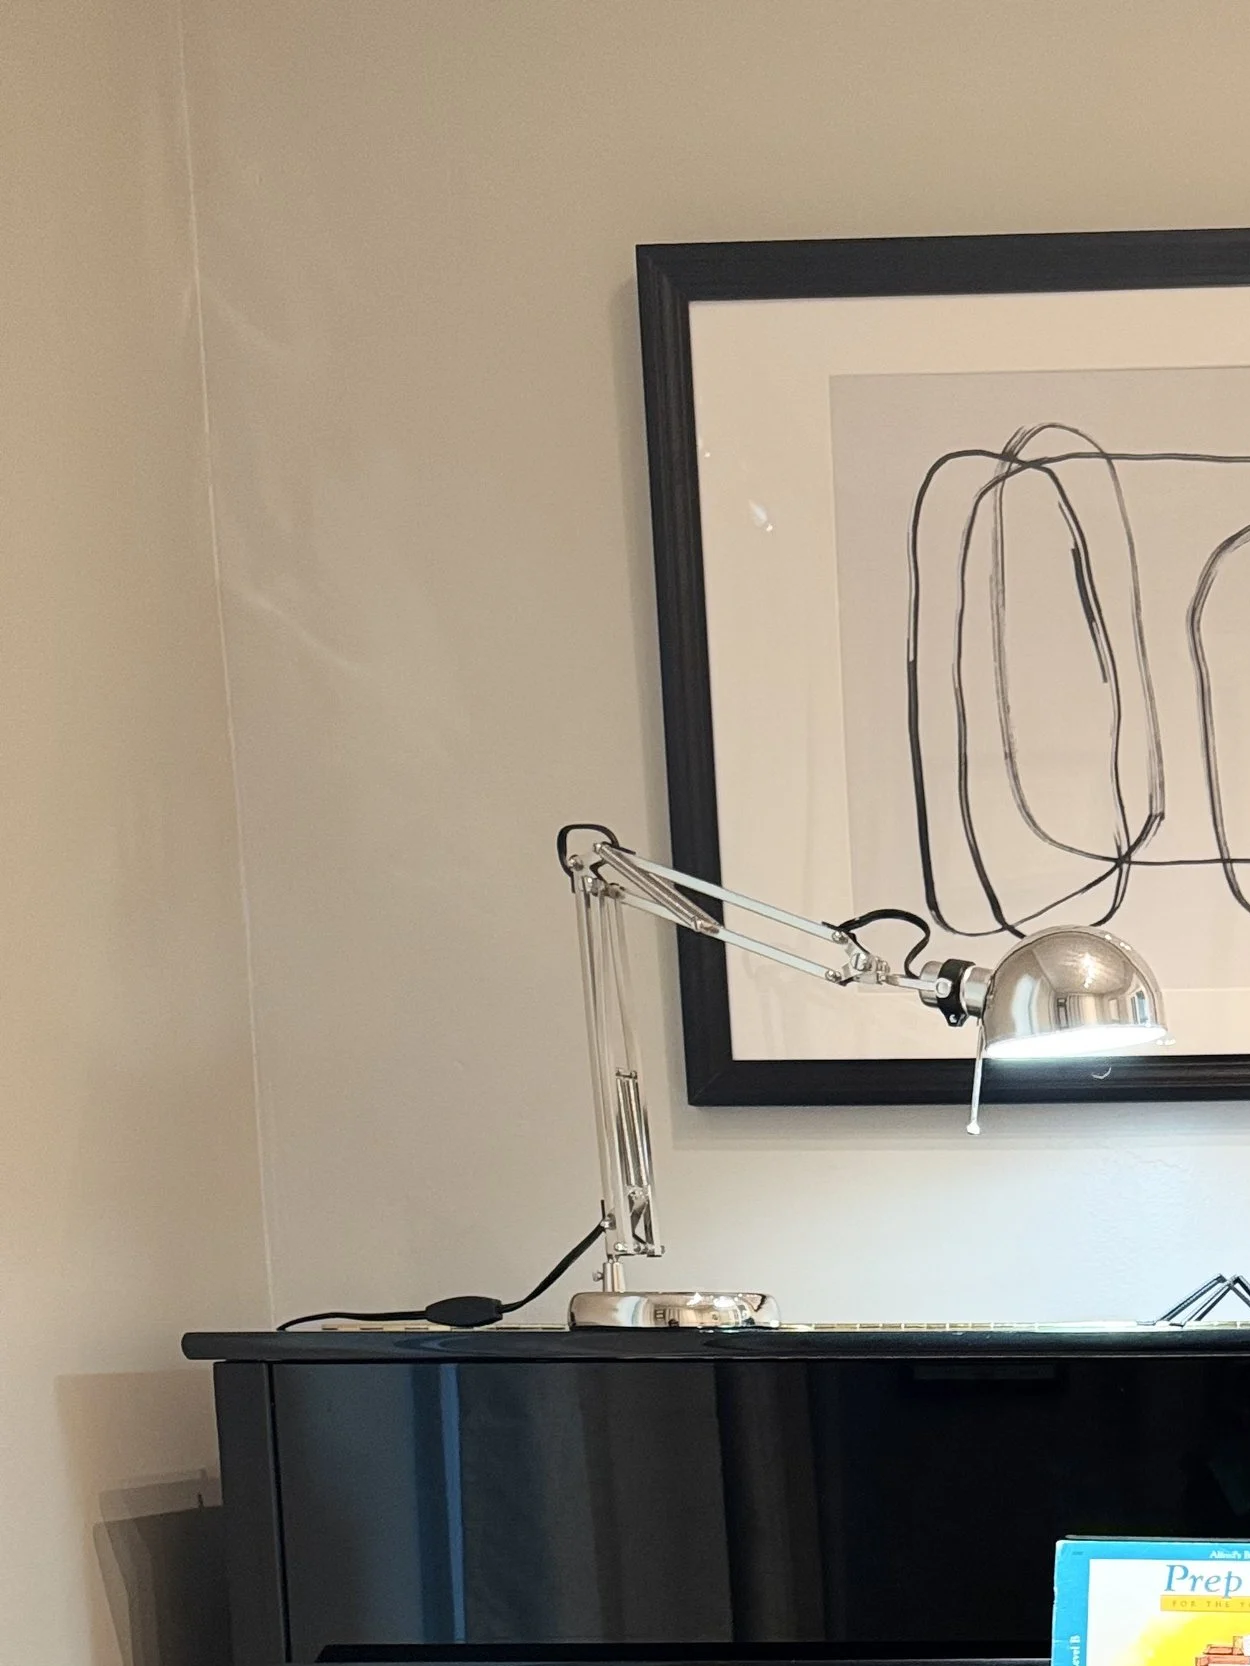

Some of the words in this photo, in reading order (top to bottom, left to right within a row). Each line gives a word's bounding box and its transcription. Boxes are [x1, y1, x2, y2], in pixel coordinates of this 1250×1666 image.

[1164, 1564, 1243, 1599] Prep
[1172, 1600, 1195, 1608] FOR
[1206, 1600, 1230, 1608] THE
[1070, 1634, 1081, 1643] B
